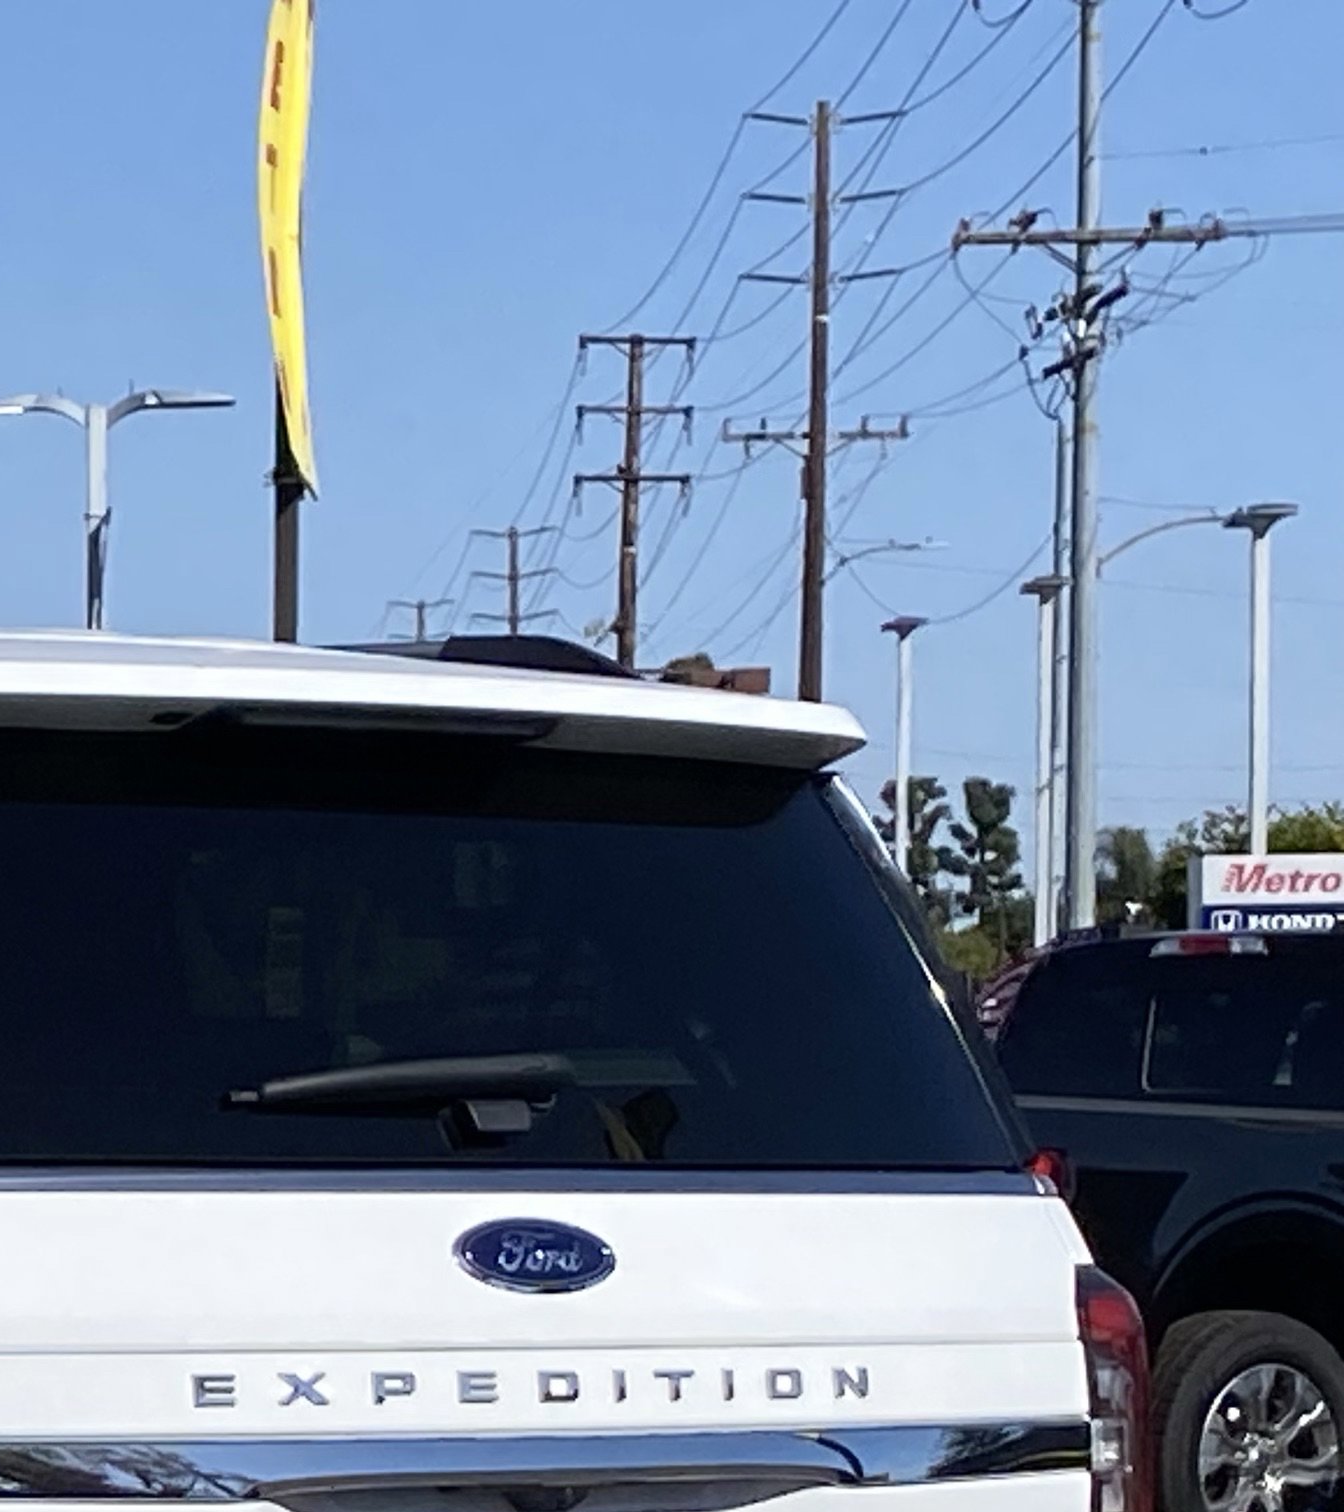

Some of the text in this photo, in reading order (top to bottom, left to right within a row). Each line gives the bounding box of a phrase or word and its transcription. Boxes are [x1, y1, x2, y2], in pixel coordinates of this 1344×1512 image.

[1221, 863, 1342, 893] Metro
[1248, 913, 1344, 931] HOND
[498, 1230, 584, 1273] Ford
[190, 1366, 871, 1409] EXPEDITION
